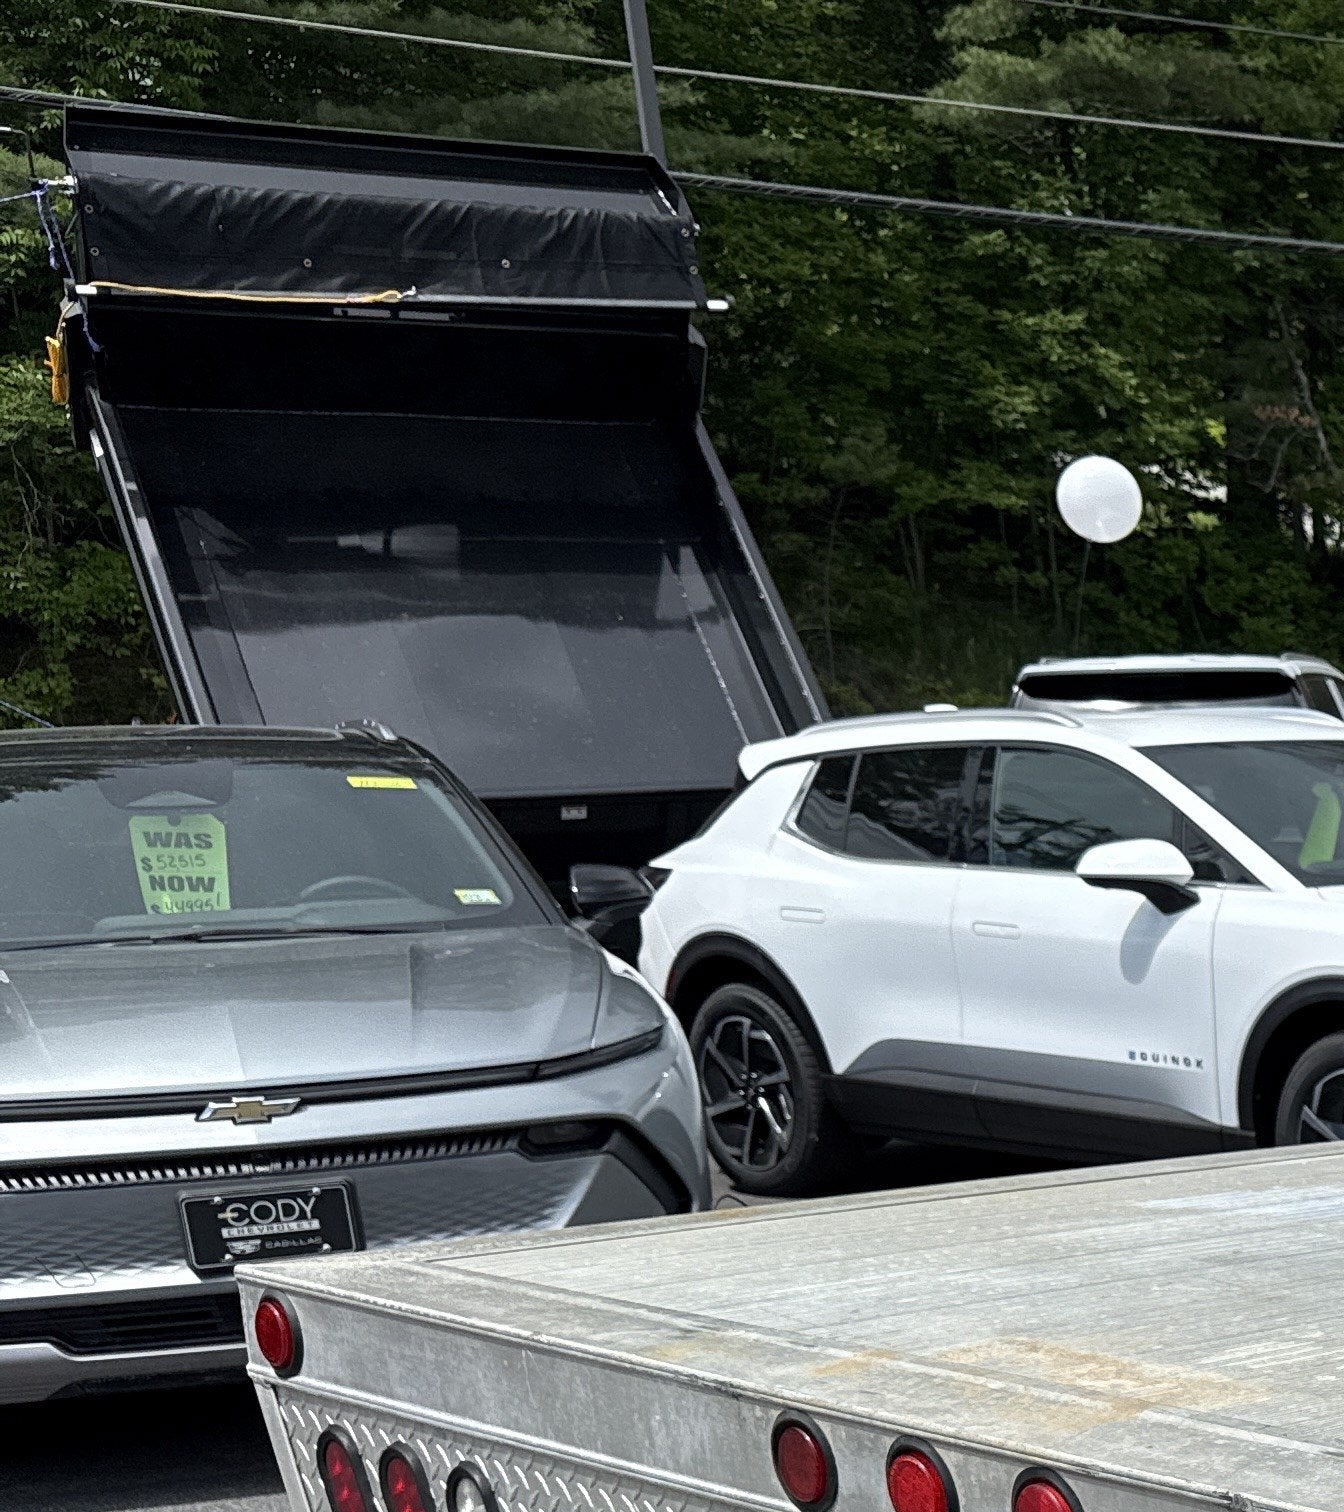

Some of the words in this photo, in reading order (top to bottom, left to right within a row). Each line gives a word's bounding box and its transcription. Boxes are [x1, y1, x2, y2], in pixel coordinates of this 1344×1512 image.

[142, 831, 213, 849] WAS
[148, 874, 216, 892] NOW
[1128, 1050, 1203, 1069] EQUINOX
[225, 1196, 317, 1227] CODY
